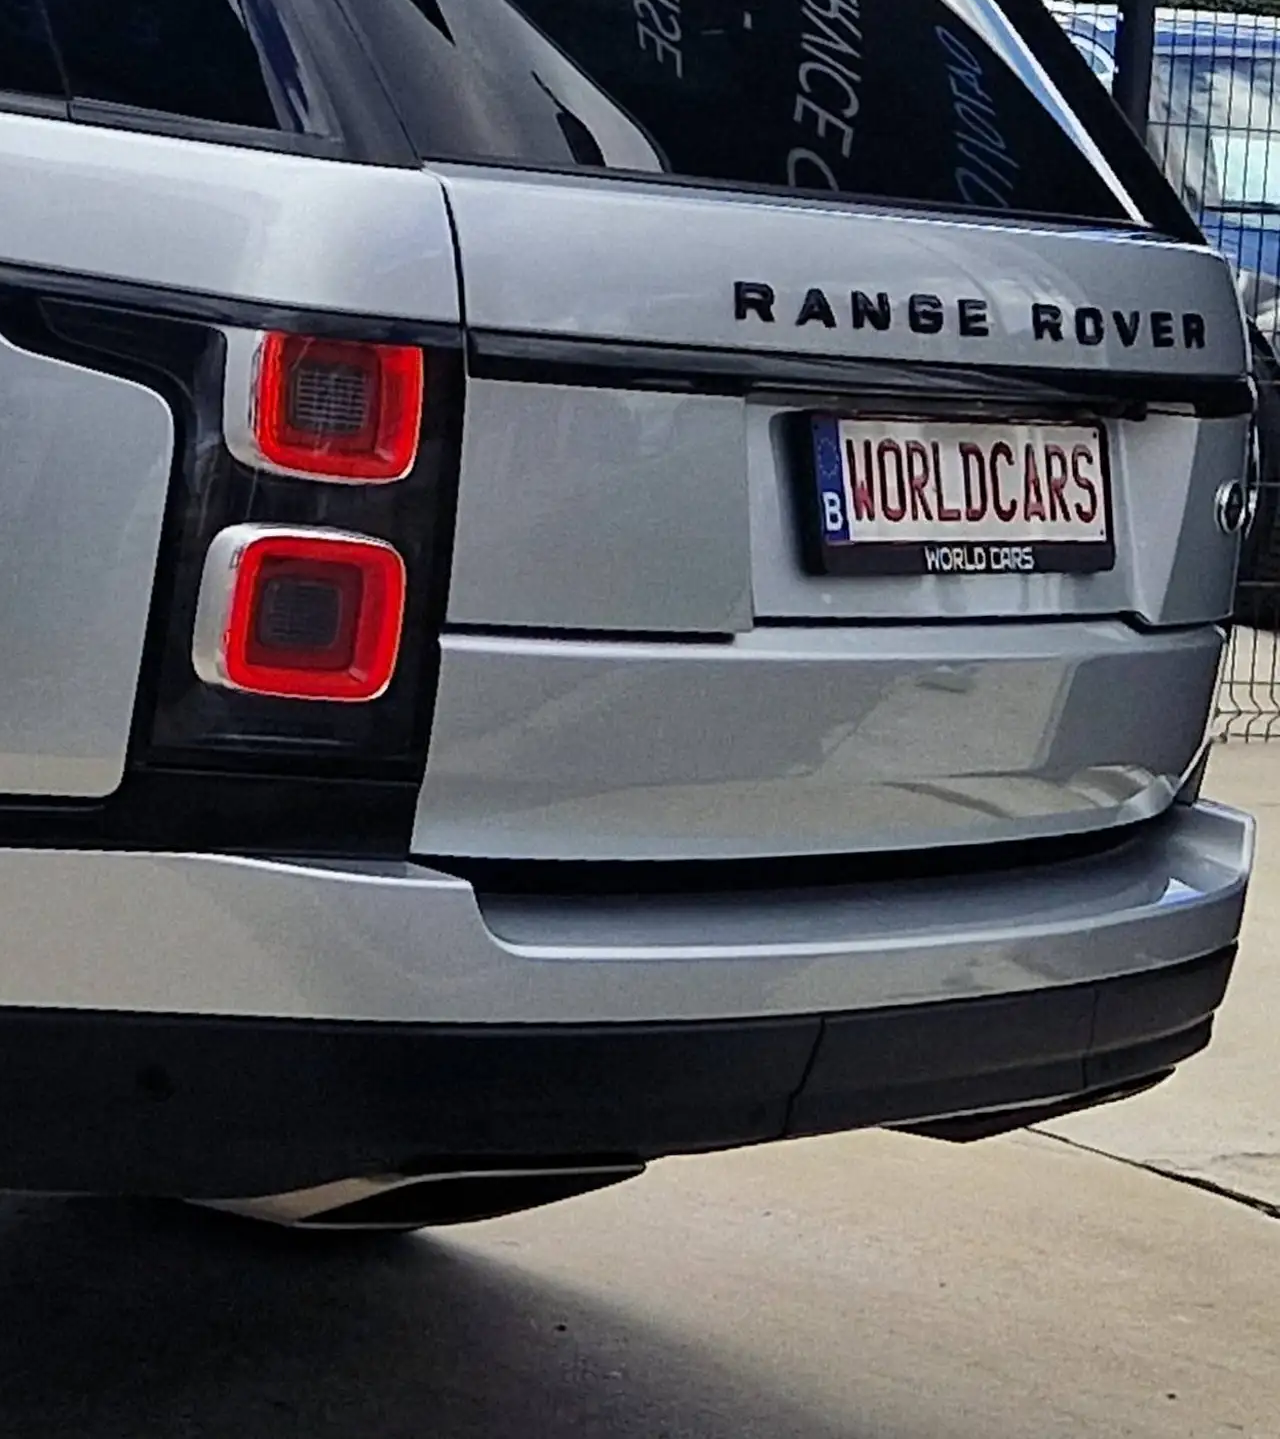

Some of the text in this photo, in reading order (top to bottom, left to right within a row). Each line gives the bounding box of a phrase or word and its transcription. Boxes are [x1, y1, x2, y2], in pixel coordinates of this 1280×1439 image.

[733, 280, 1206, 349] RANGE ROVER
[821, 438, 1098, 531] B WORLDCARS
[924, 545, 1035, 571] WORLD CARS
